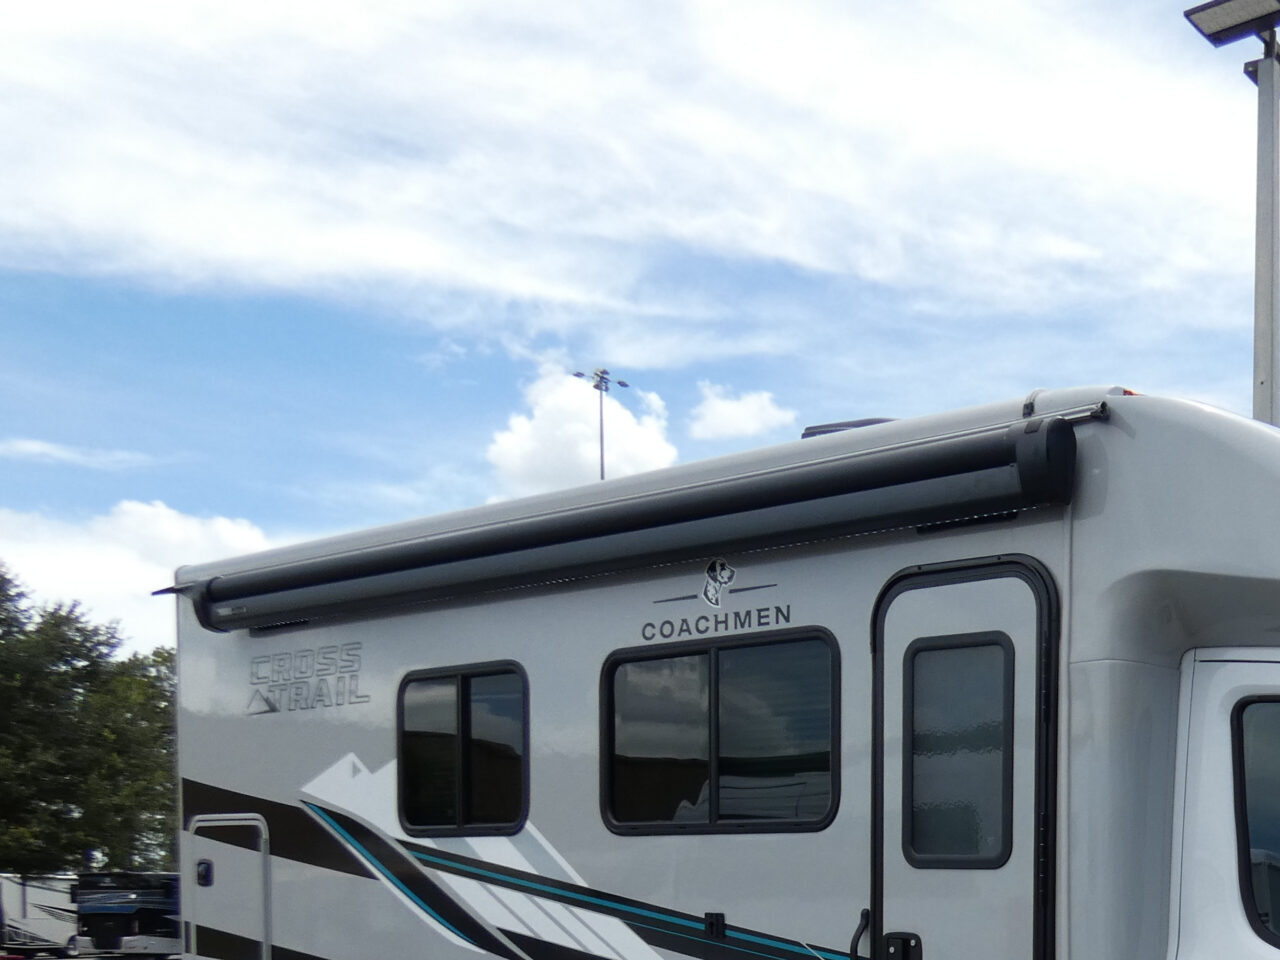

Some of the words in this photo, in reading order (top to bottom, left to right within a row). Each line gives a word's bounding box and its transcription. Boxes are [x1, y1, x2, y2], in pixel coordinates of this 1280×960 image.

[641, 604, 791, 641] COACHMEN
[249, 641, 362, 685] CROSS
[267, 674, 371, 711] TRAIL
